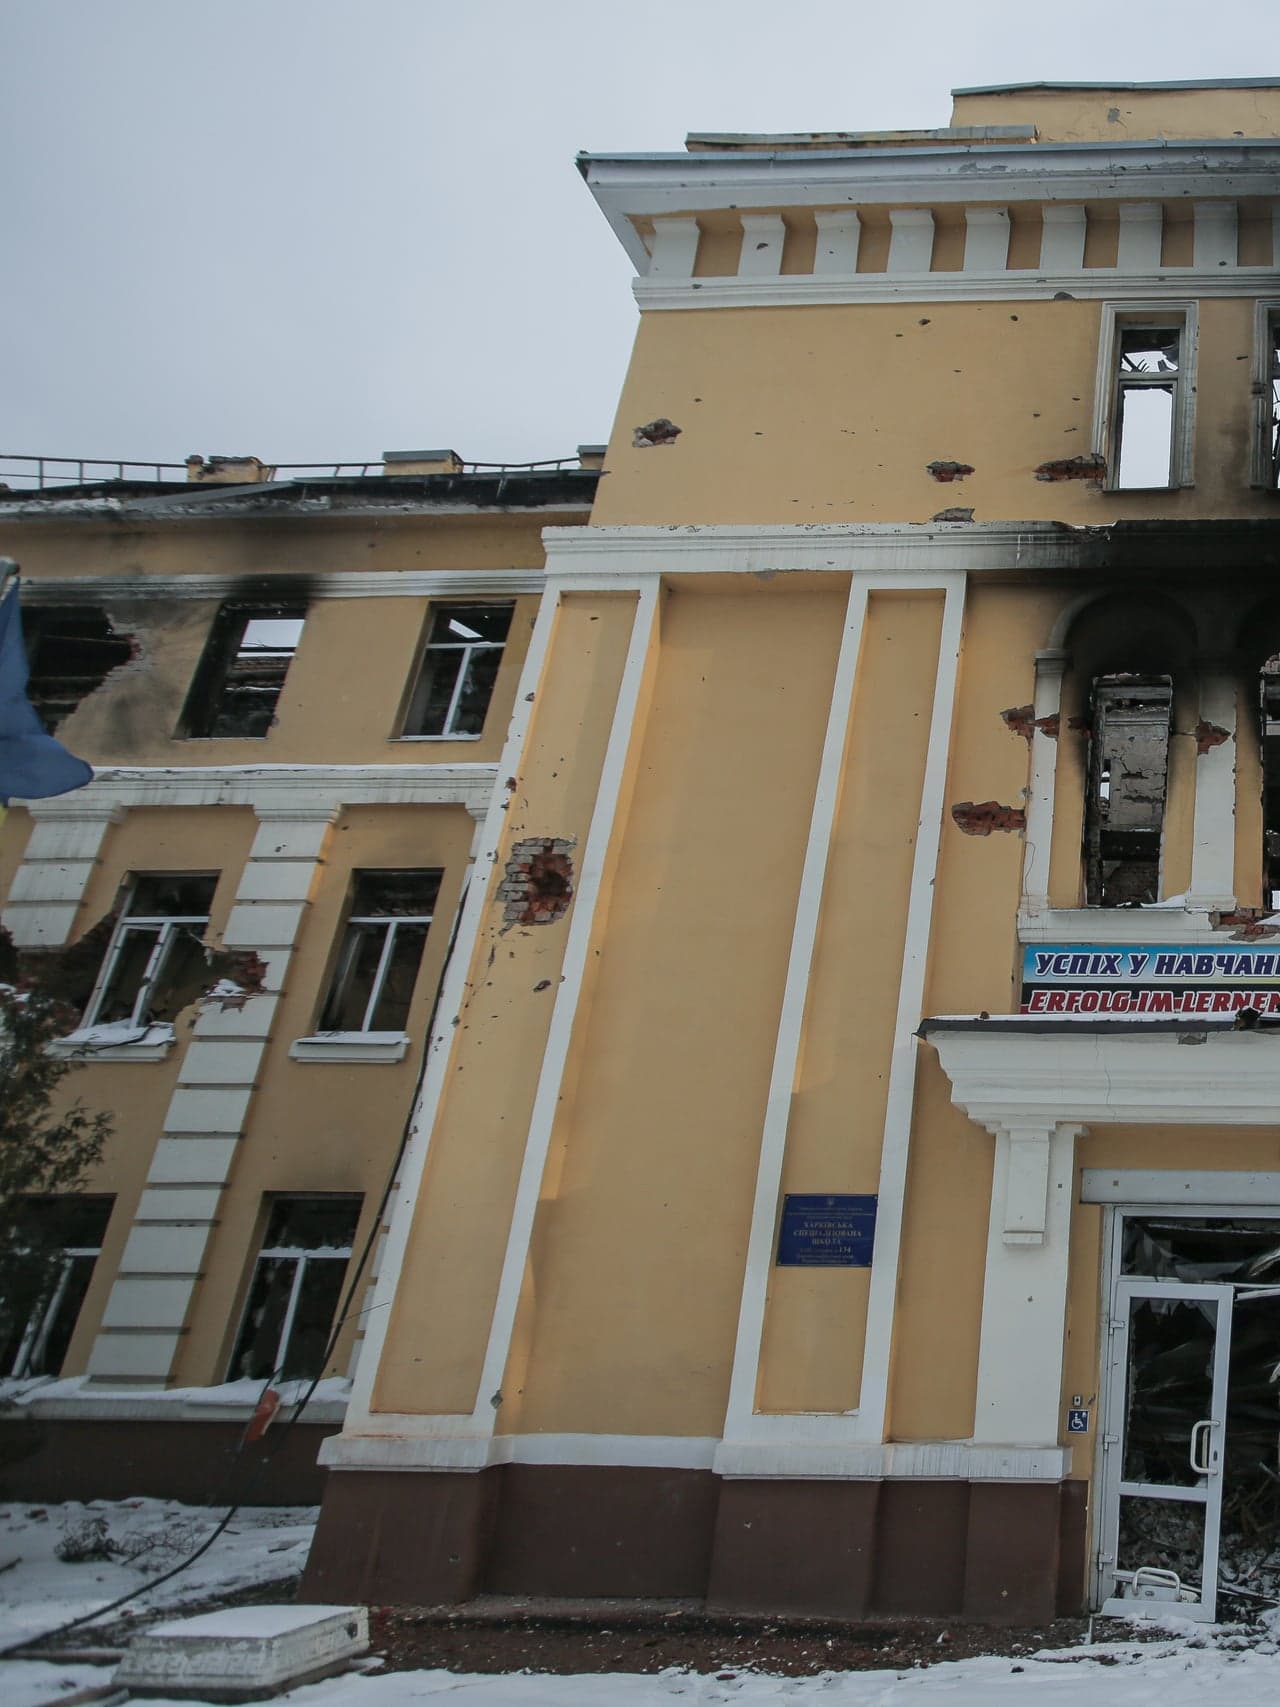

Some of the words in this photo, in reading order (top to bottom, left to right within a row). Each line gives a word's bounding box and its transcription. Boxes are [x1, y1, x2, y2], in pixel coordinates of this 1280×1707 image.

[1035, 952, 1123, 977] УСПІХ
[1128, 953, 1149, 977] У
[1028, 990, 1132, 1014] ERFOLG
[1134, 991, 1176, 1014] IM
